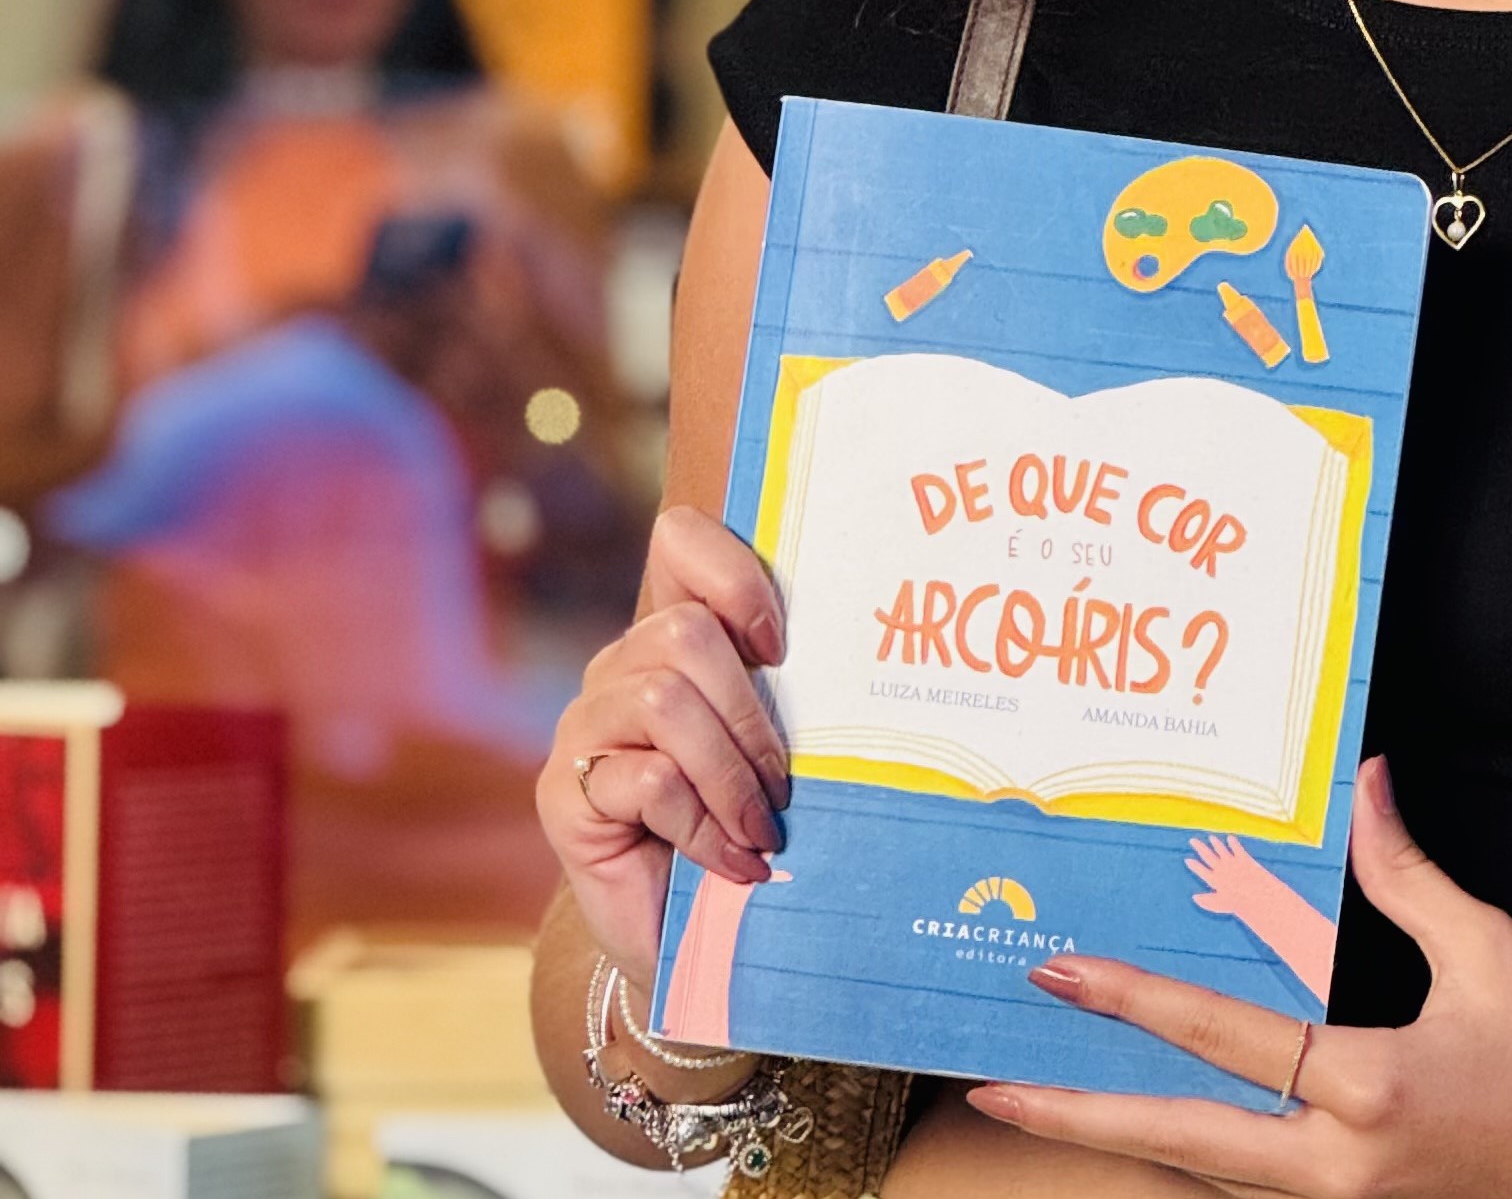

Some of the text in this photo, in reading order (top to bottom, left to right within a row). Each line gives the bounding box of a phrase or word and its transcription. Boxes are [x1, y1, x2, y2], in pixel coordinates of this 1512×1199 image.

[910, 453, 1248, 578] DE QUE COR
[1008, 529, 1113, 567] É O SEU
[869, 680, 1020, 713] LUIZA MEIRELES
[1081, 707, 1219, 737] AMANDA BAHIA
[911, 918, 1076, 954] CRIACRIANÇA
[955, 948, 1027, 967] editora
